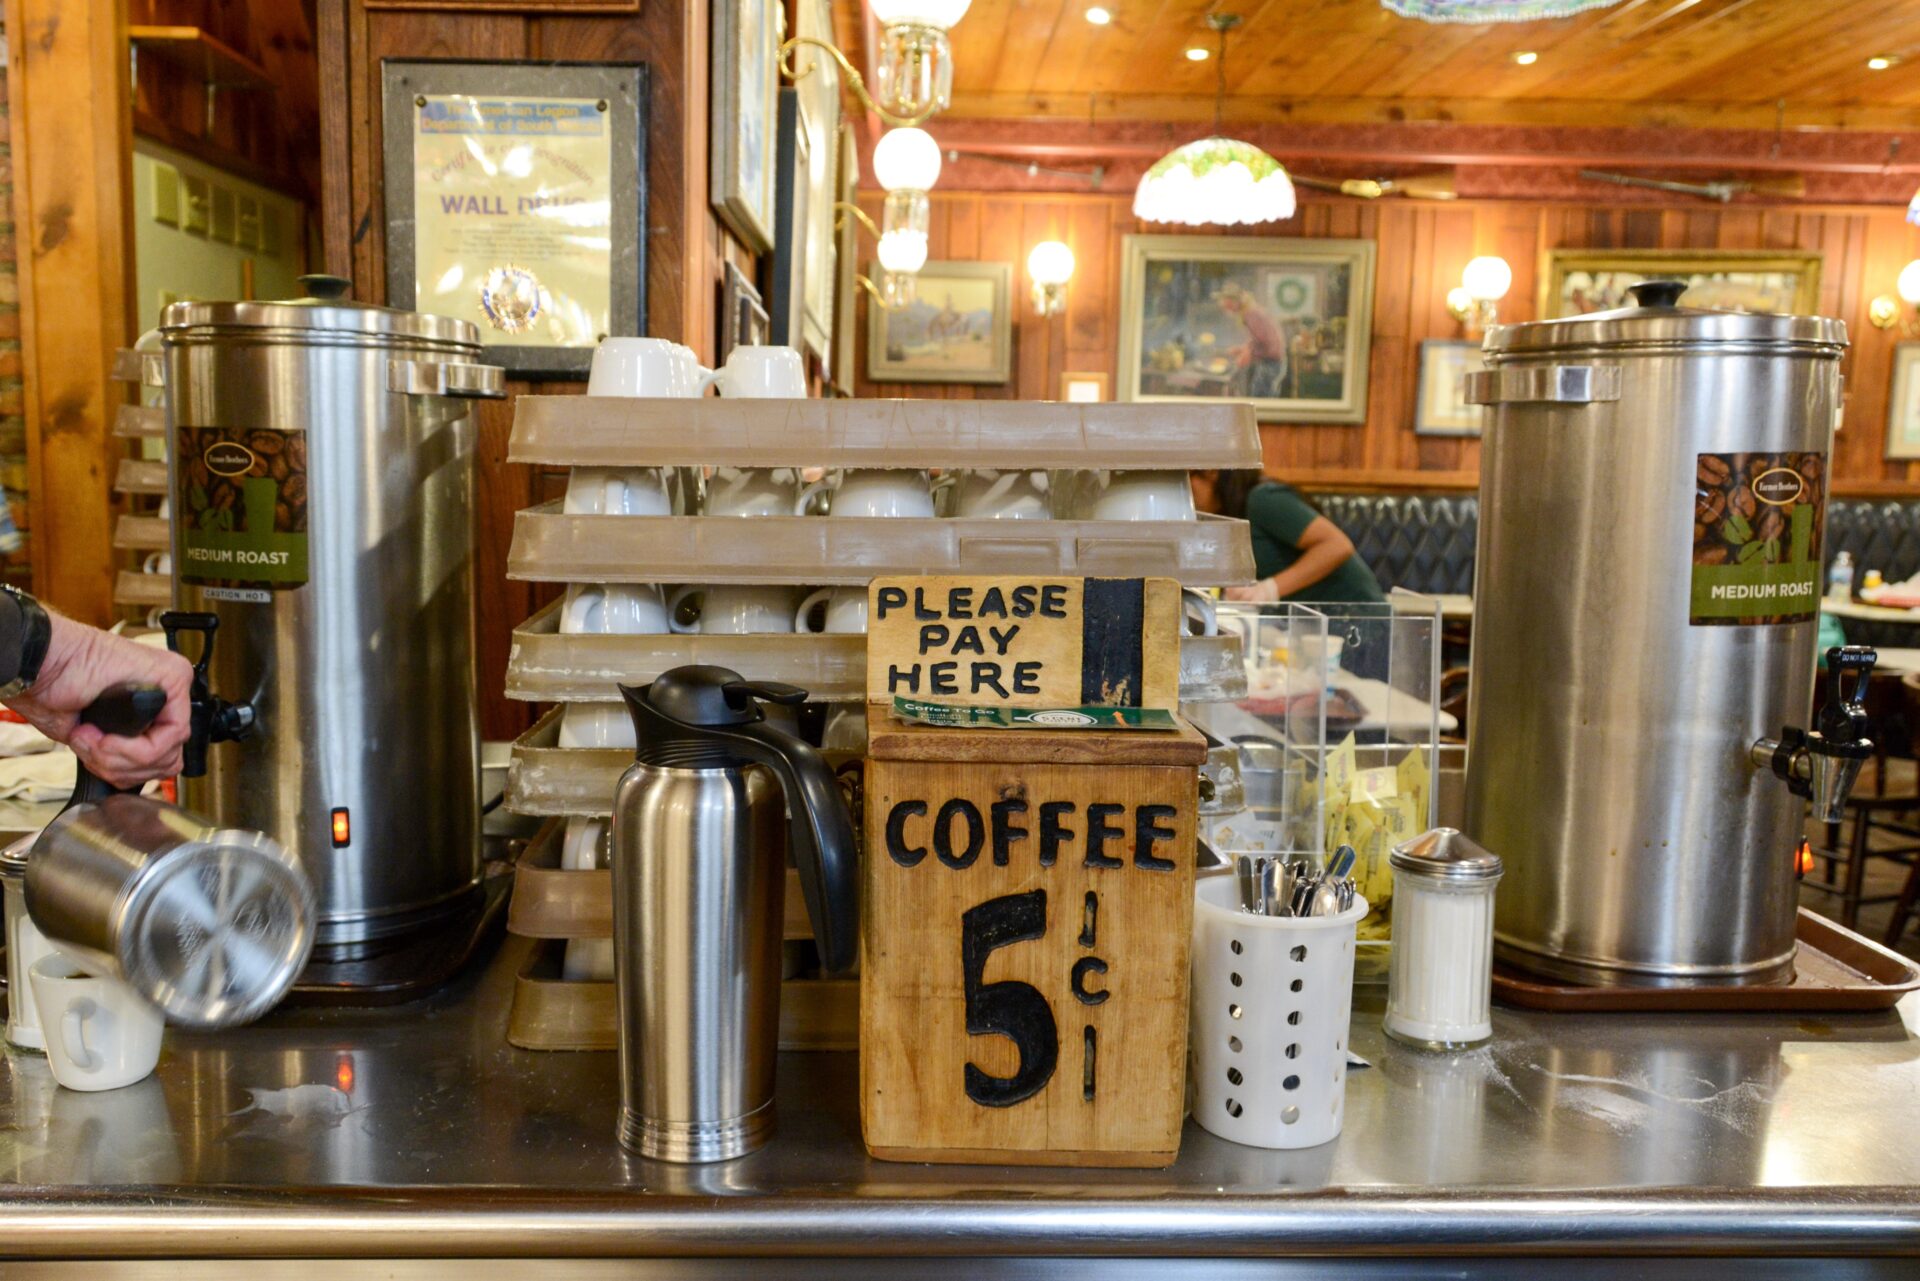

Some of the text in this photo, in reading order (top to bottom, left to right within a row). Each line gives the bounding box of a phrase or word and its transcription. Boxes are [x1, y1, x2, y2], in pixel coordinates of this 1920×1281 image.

[441, 195, 508, 215] WALL
[187, 547, 289, 565] MEDIUM ROAST
[205, 588, 265, 600] CAUTION HOT
[1711, 580, 1813, 600] MEDIUM ROAST
[877, 584, 1068, 620] PLEASE
[918, 624, 1020, 655] PAY
[888, 661, 1043, 699] HERE
[904, 703, 950, 713] Coffee
[886, 798, 1177, 871] COFFEE
